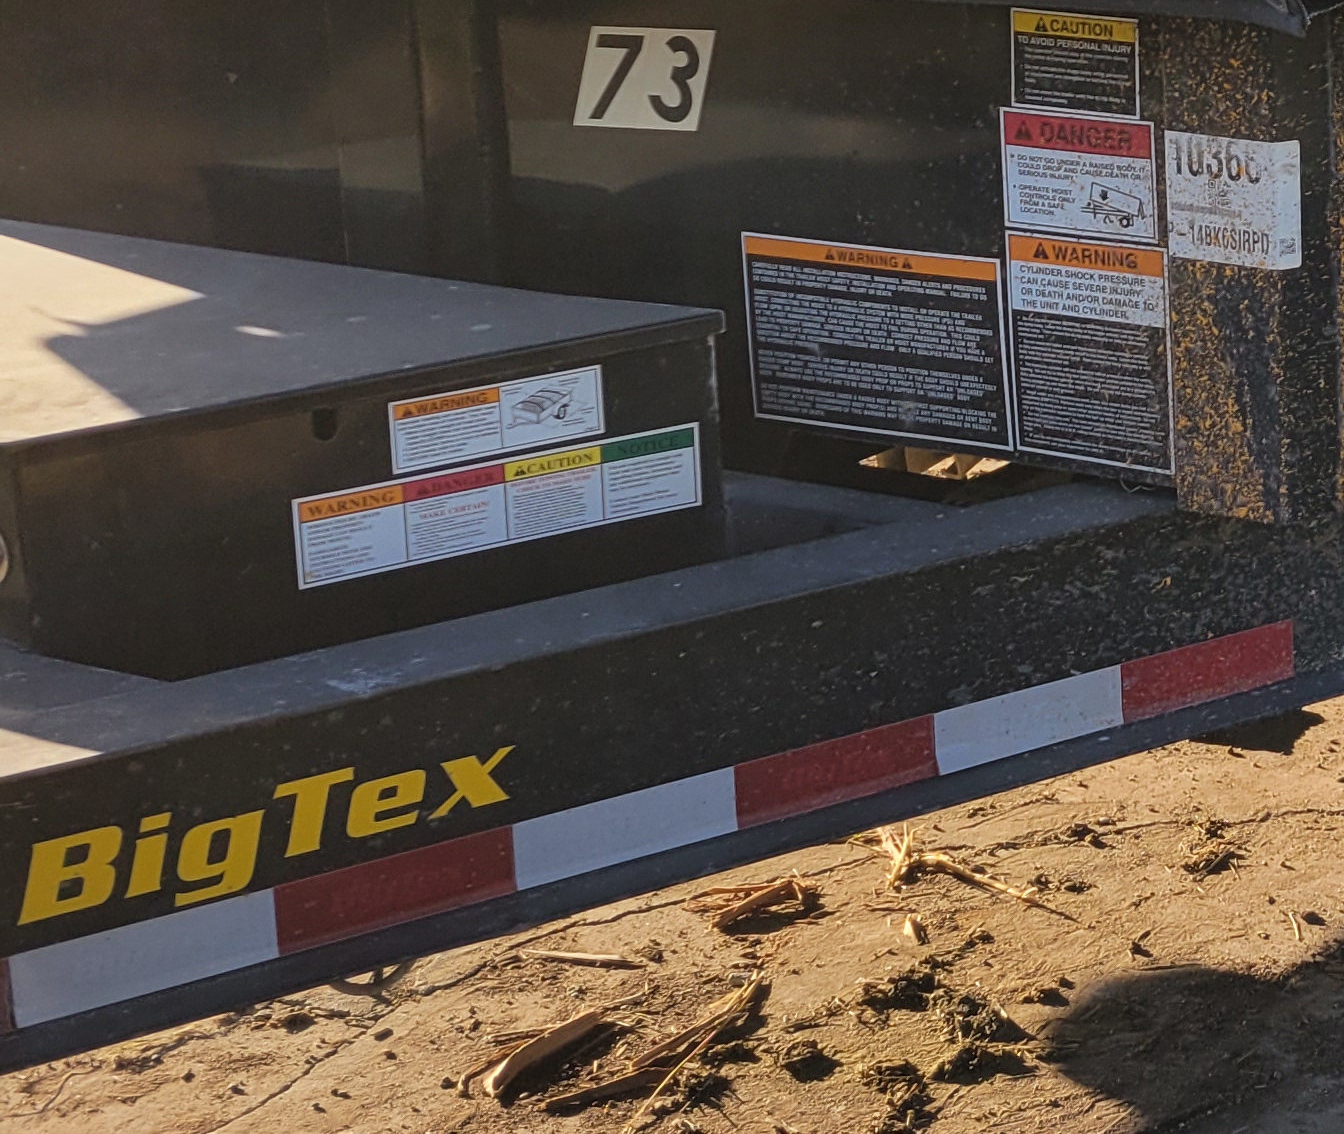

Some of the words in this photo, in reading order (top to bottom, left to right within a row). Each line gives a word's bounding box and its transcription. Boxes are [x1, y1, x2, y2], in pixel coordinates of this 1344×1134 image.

[1051, 19, 1113, 37] CAUTION
[588, 34, 699, 122] 73
[1040, 122, 1132, 150] DANGER
[837, 250, 898, 268] WARNING
[1052, 244, 1137, 269] WARNING
[1020, 265, 1063, 277] CYLINDER
[1065, 270, 1096, 281] SHOCK
[1098, 274, 1145, 287] PRESSURE
[1020, 276, 1038, 285] CAN
[1040, 278, 1070, 289] CAUSE
[1072, 282, 1108, 293] SEVERE
[1021, 287, 1032, 295] OR
[1035, 288, 1063, 300] DEATH
[1102, 296, 1140, 309] DAMAGE
[1022, 299, 1038, 308] THE
[1040, 300, 1059, 310] UNIT
[1062, 303, 1080, 313] AND
[415, 392, 488, 414] WARNING
[618, 435, 680, 455] NOTICE
[527, 453, 593, 474] CAUTION
[307, 491, 394, 517] WARNING
